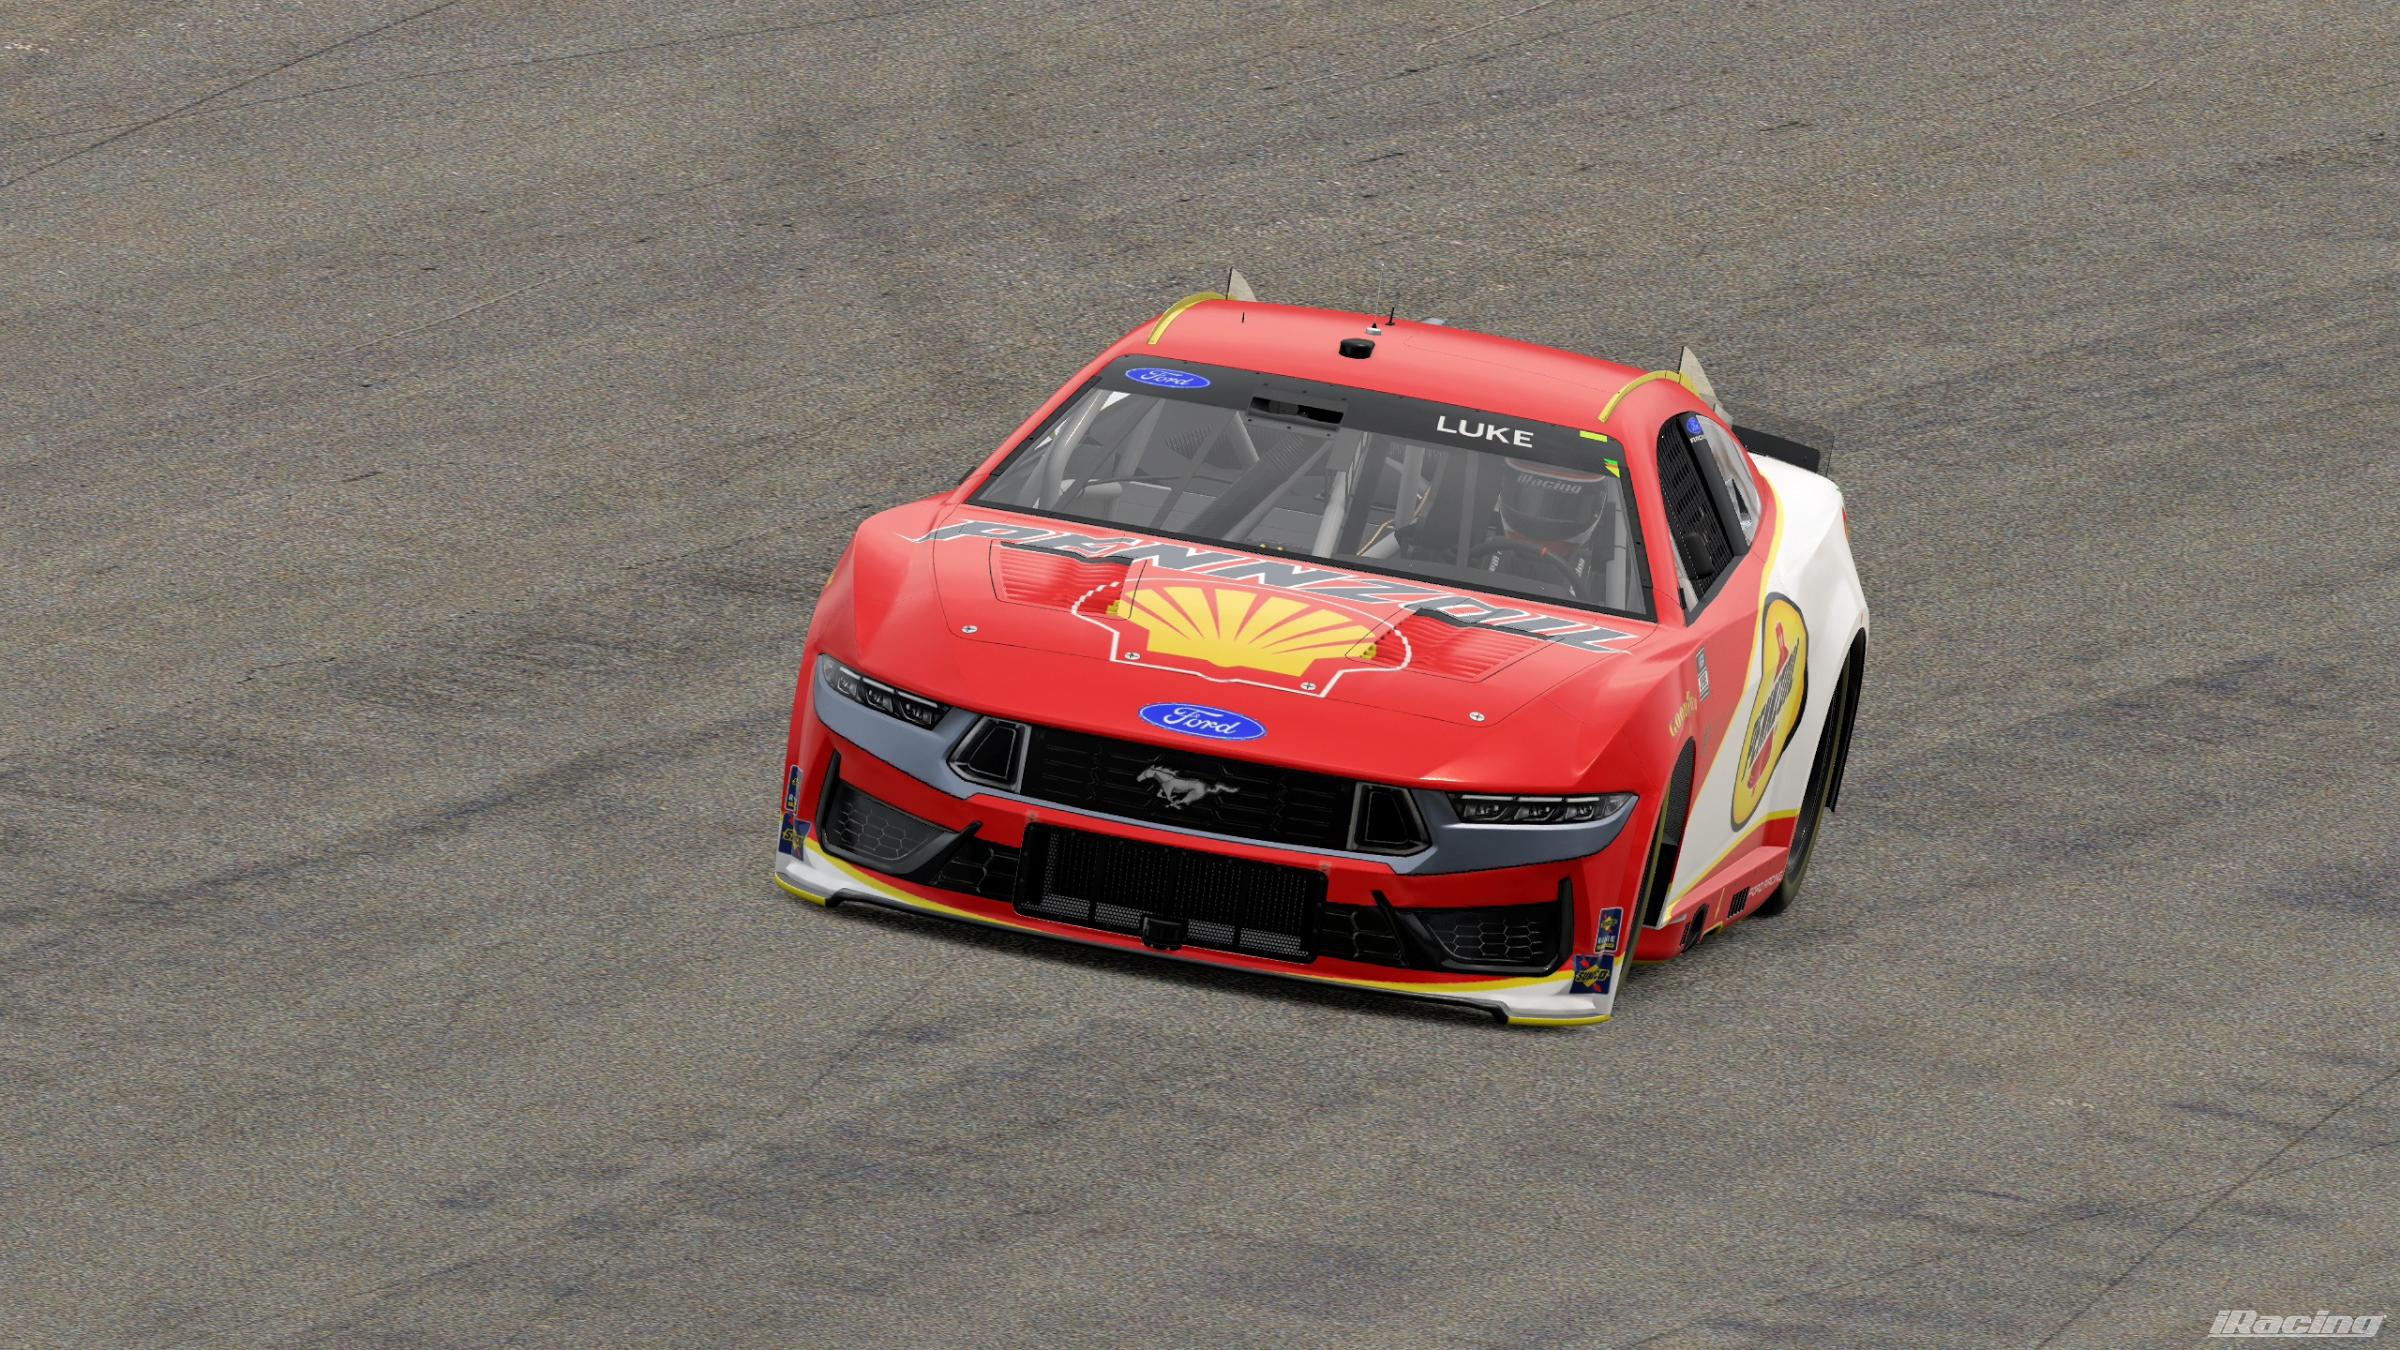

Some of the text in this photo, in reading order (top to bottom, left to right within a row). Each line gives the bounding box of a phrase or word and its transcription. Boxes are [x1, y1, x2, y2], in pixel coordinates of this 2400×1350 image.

[1140, 370, 1194, 386] Ford
[1436, 415, 1534, 449] LUKE
[1516, 471, 1582, 496] iRacing
[895, 518, 1638, 655] PENNZOIL
[1163, 706, 1242, 735] Ford
